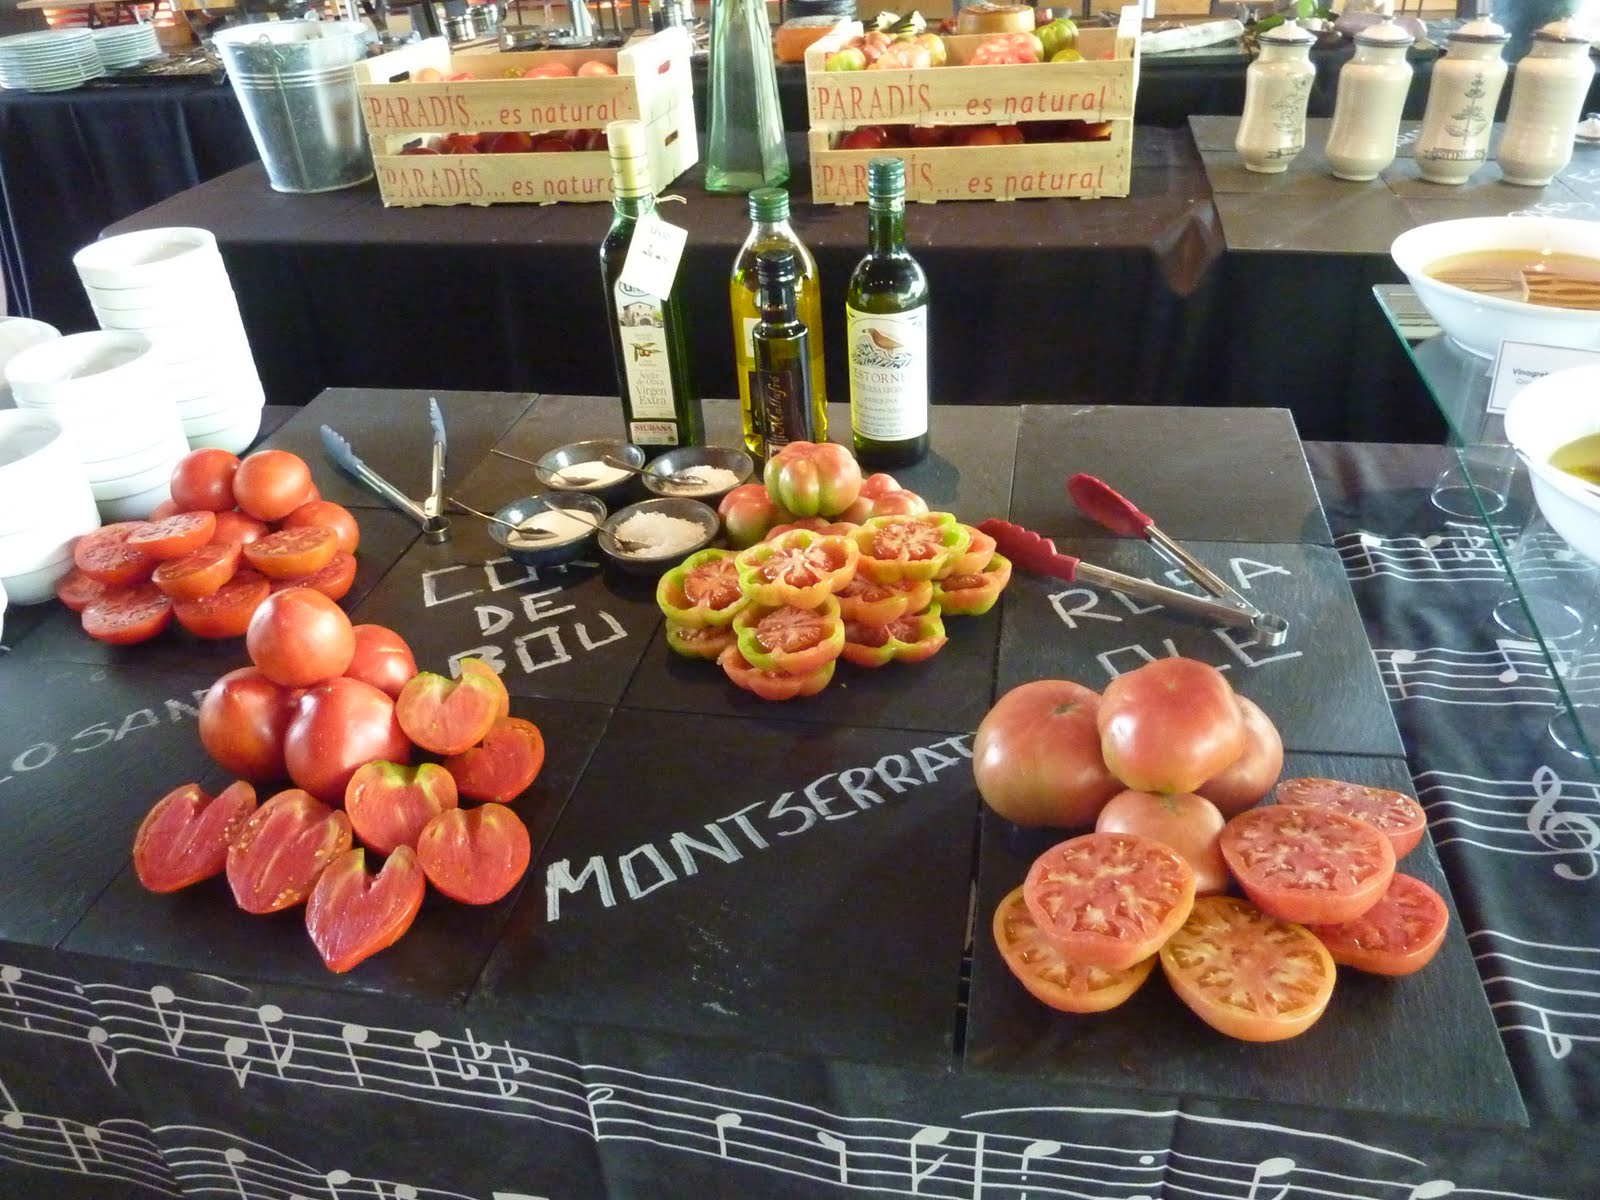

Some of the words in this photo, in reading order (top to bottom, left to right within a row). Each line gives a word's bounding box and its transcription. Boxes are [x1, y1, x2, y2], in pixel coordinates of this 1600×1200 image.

[500, 107, 521, 125] es
[531, 97, 619, 124] natural
[966, 97, 992, 116] es
[1004, 86, 1107, 115] natural
[512, 179, 535, 195] es
[968, 175, 994, 193] es
[1006, 166, 1104, 192] natural
[636, 386, 667, 397] Virgen
[639, 396, 667, 406] Extra
[474, 586, 577, 637] DE
[545, 733, 974, 923] MONTSERRAT
